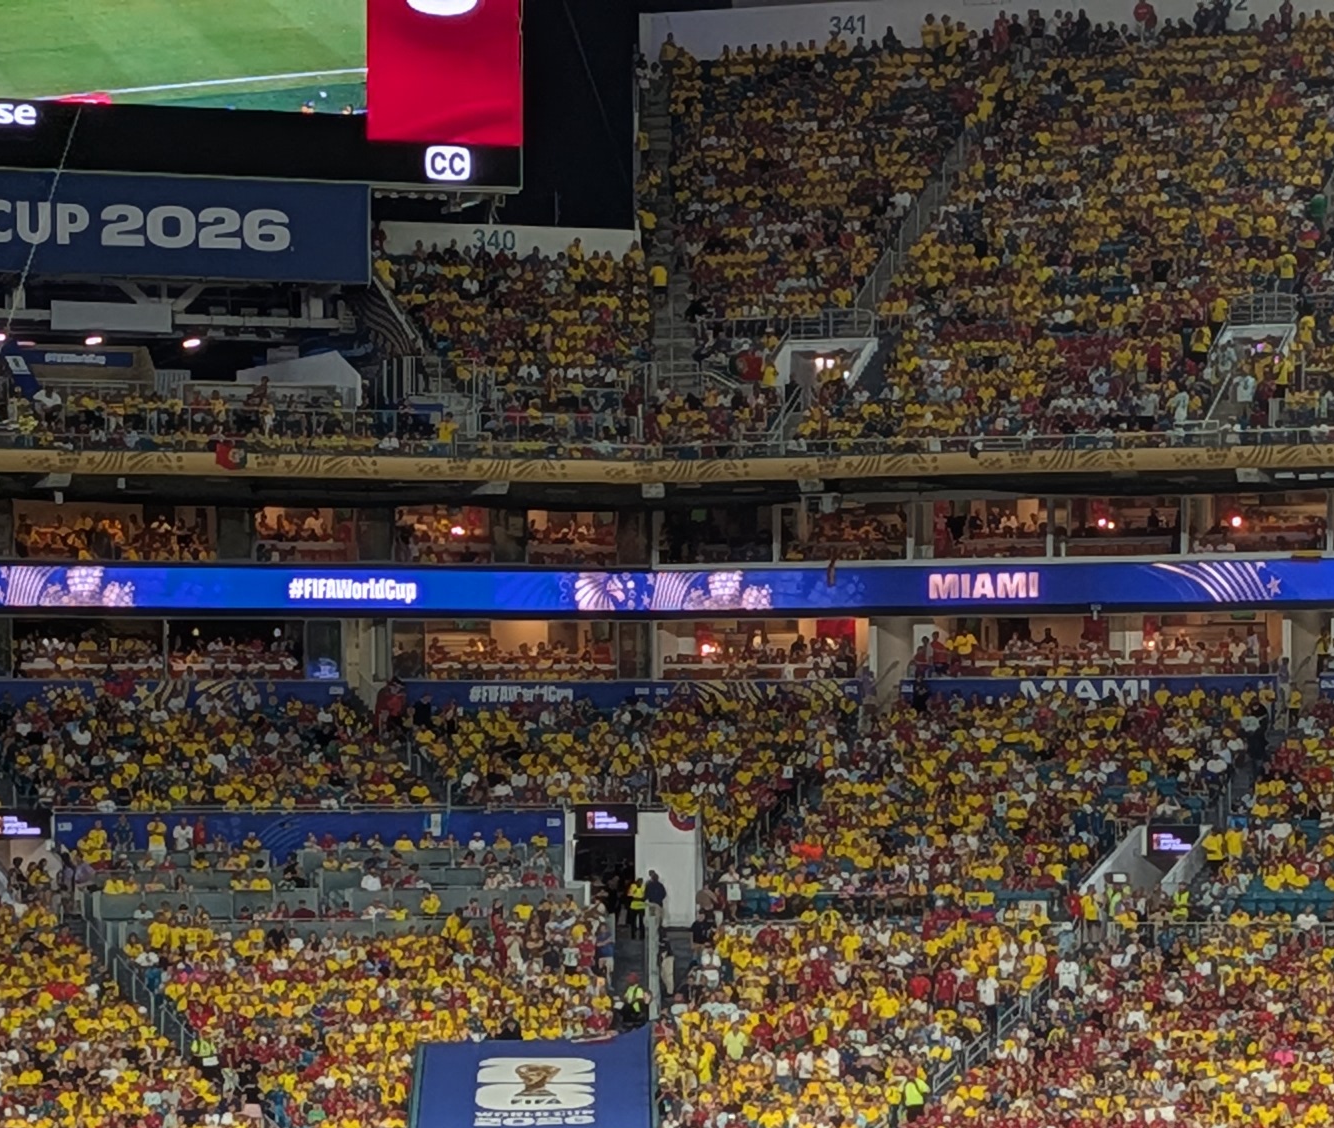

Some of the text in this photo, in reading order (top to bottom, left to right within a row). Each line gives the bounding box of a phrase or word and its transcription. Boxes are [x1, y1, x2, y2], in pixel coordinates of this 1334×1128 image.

[829, 14, 866, 35] 341
[431, 151, 465, 177] CC
[100, 203, 291, 252] 2026
[472, 229, 515, 251] 340
[289, 578, 417, 604] #FIFAWorldCup
[929, 572, 1039, 599] MIAMI
